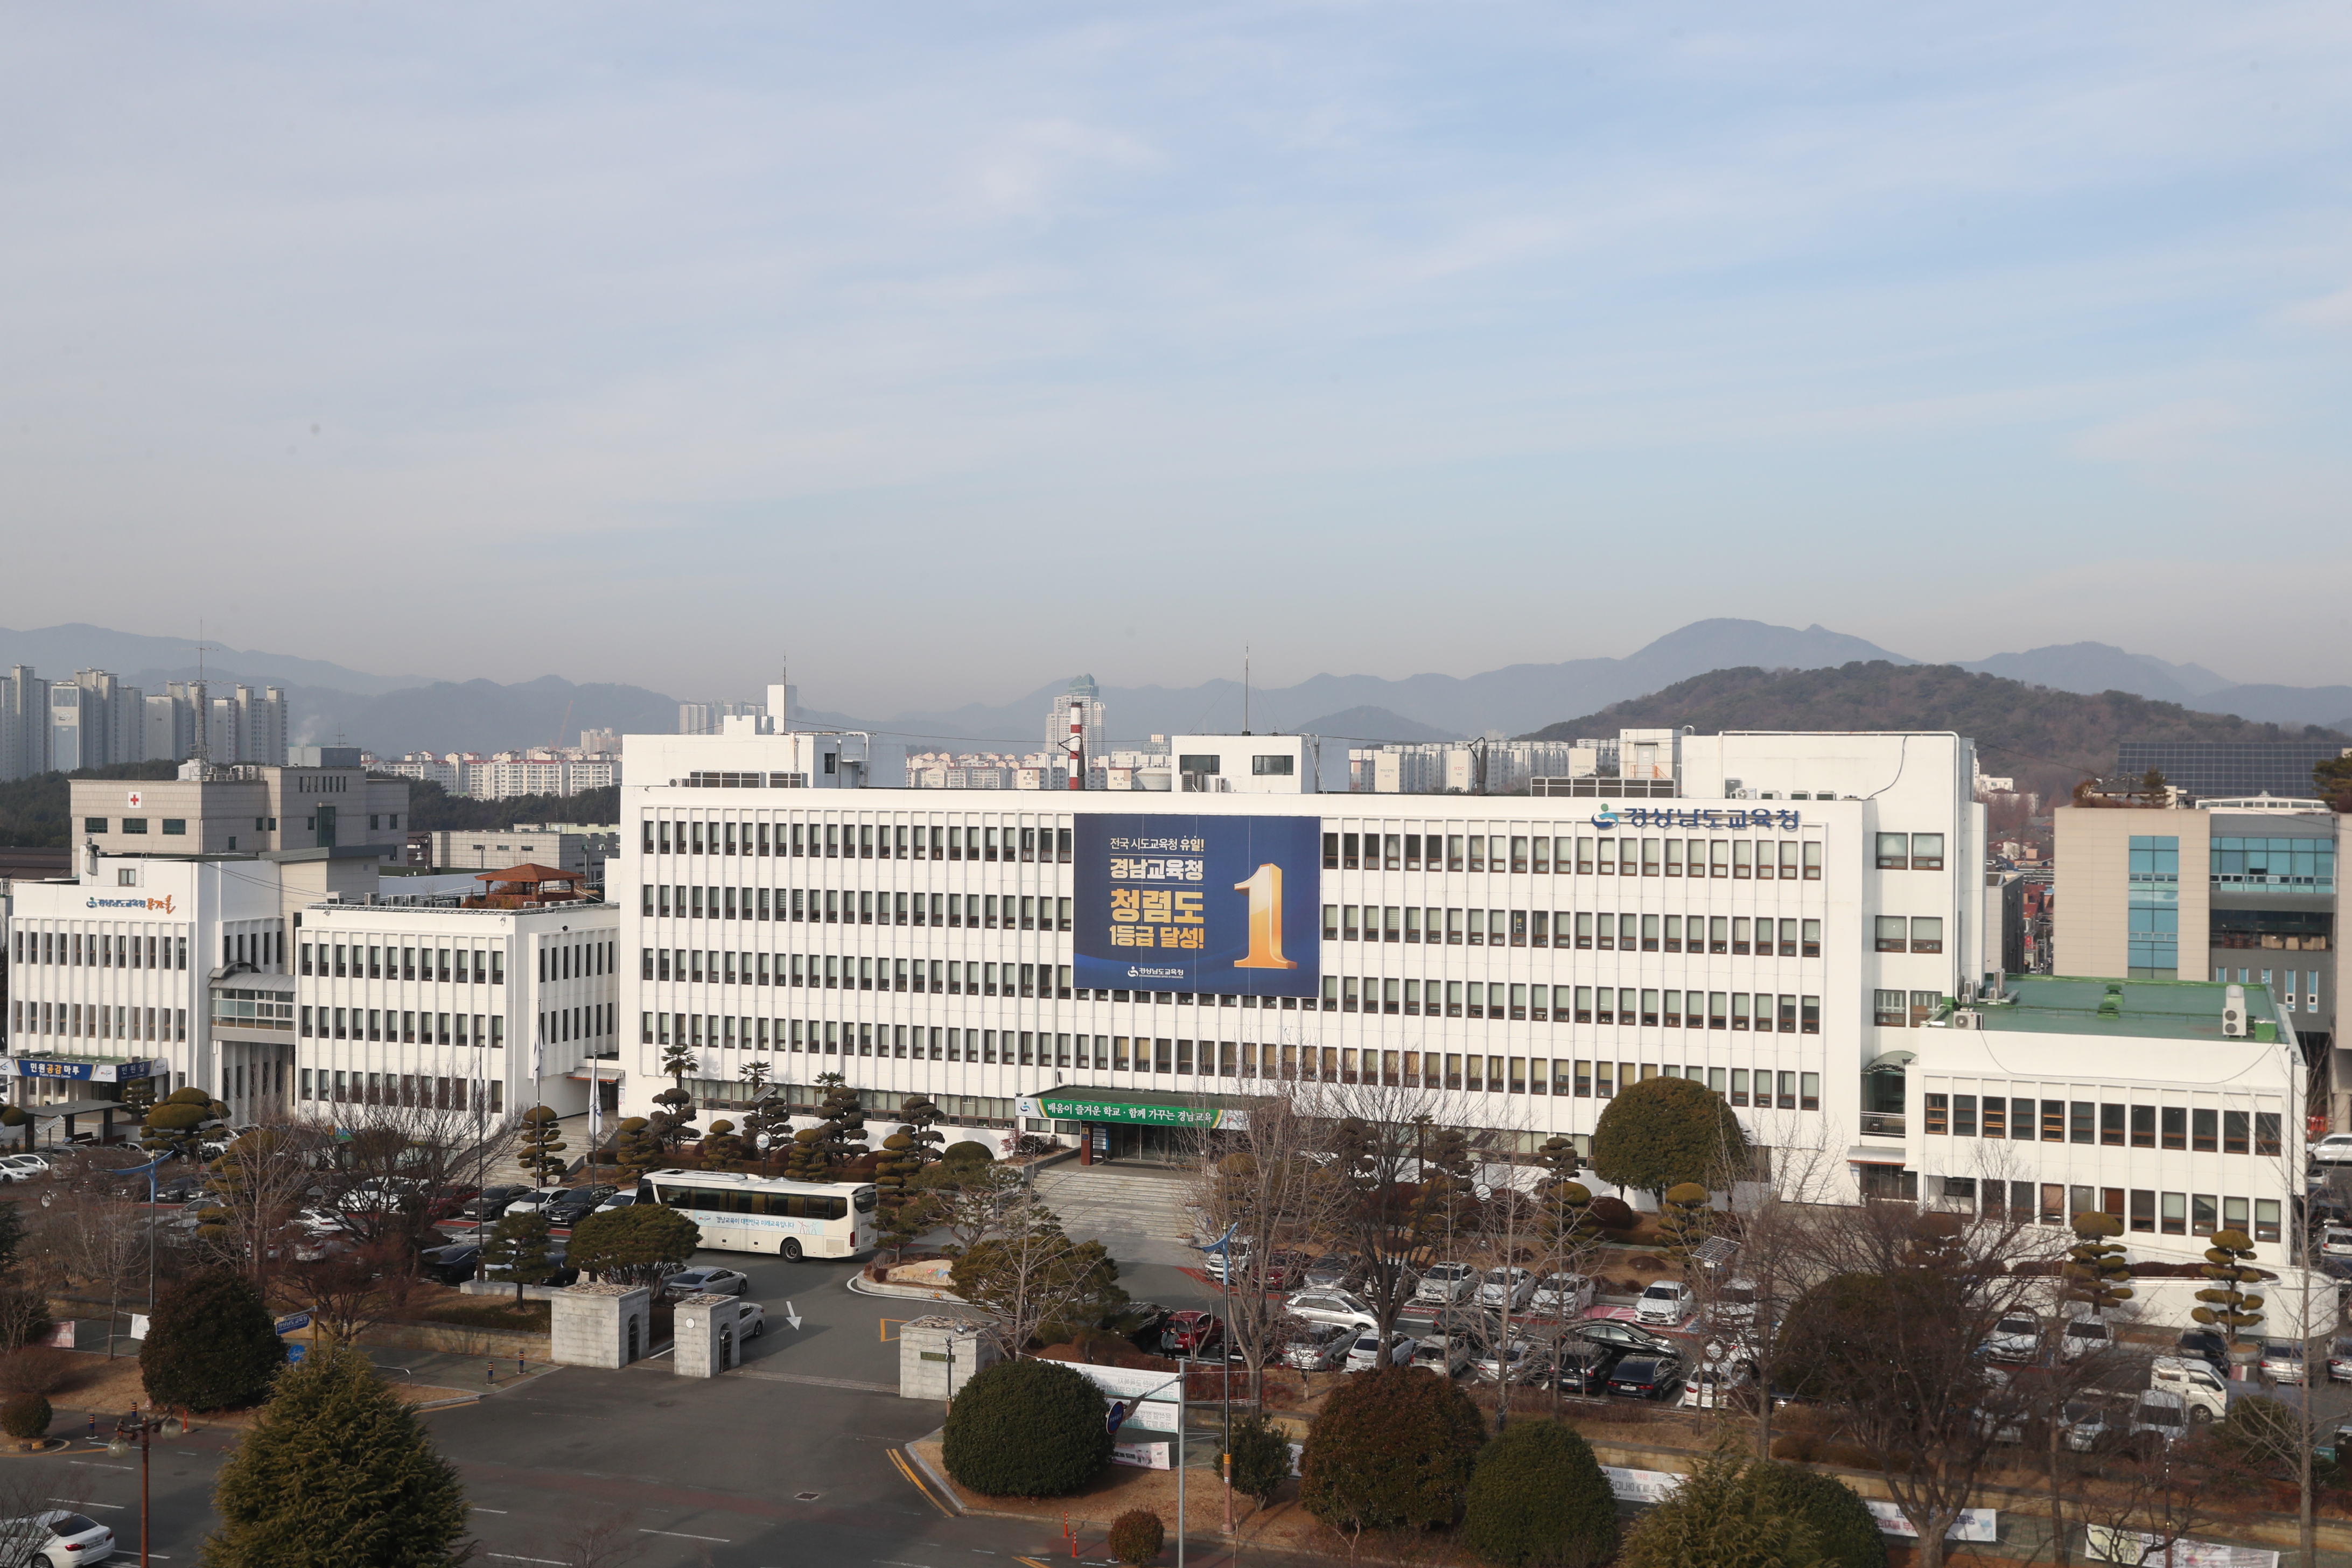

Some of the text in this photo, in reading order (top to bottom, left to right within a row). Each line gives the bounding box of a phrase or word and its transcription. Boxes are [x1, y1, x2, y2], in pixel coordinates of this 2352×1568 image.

[1623, 808, 1799, 830] 경상남도교육청
[1110, 837, 1205, 852] 전국 시도교육청 유일!
[1110, 858, 1203, 881] 경남교육청
[1110, 888, 1204, 924] 청렴도
[1234, 863, 1298, 969] 1
[1109, 925, 1204, 949] 1등급 달성!
[1138, 967, 1184, 976] 경상남도교육청
[1047, 1102, 1213, 1123] 배움이 즐거운 학교 함께 가꾸는 경남교육
[716, 1216, 740, 1224] 경남교육이
[740, 1218, 760, 1227] 대한민국
[761, 1220, 795, 1229] 미래교육입니다
